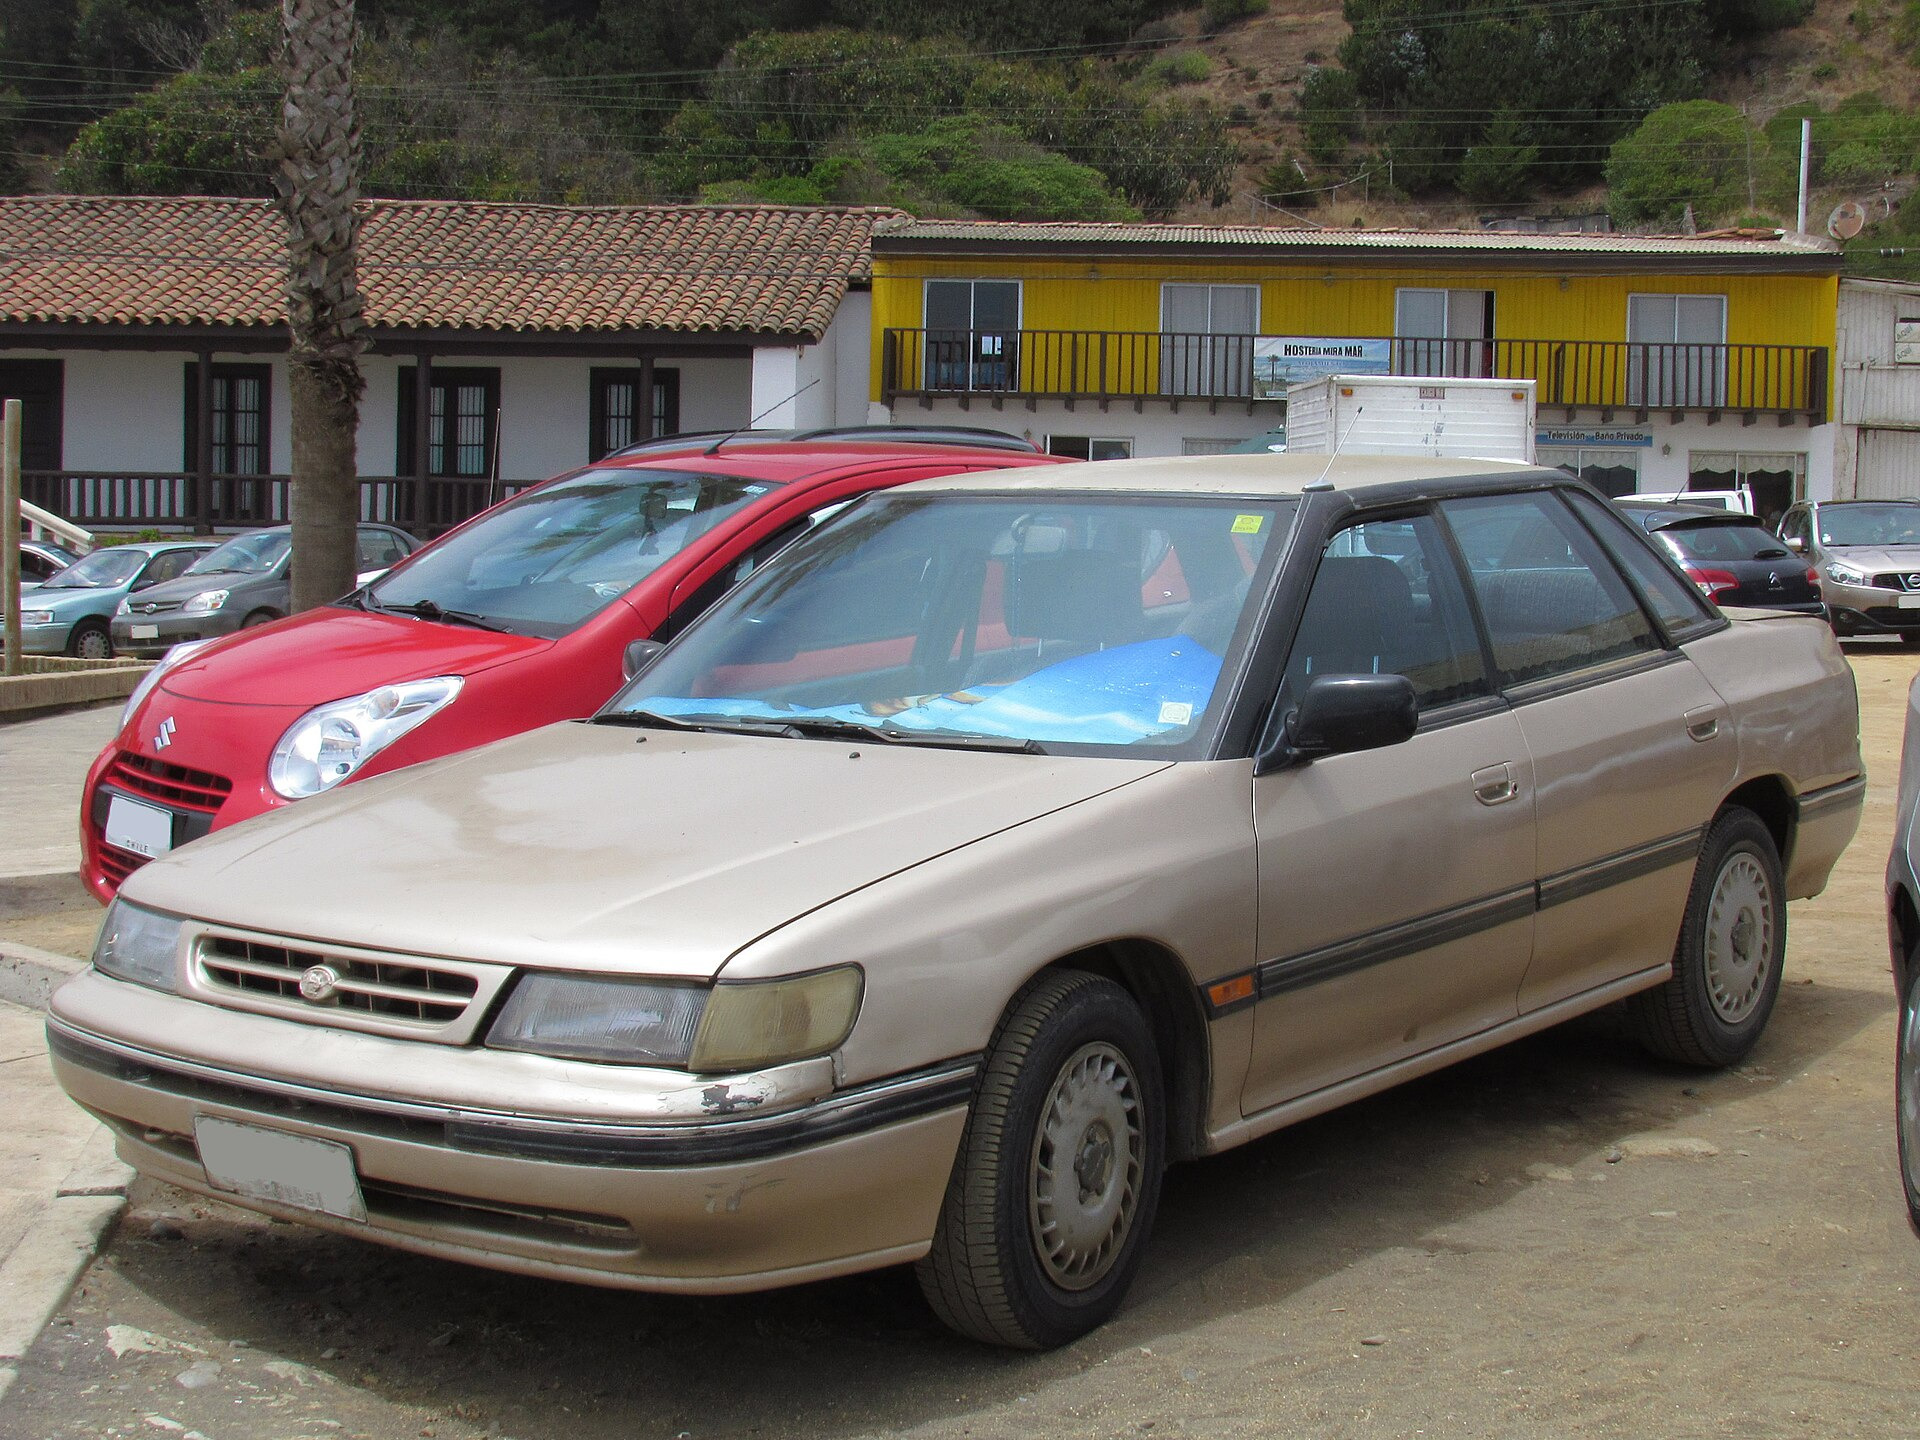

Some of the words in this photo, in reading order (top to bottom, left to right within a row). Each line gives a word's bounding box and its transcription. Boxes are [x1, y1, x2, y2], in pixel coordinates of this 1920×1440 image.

[1284, 344, 1322, 356] HOSTERIA
[1323, 347, 1343, 356] MIRA
[1345, 345, 1363, 358] MAR
[1548, 430, 1585, 441] Televisión
[1595, 431, 1614, 441] Baño
[1616, 432, 1644, 442] Privado
